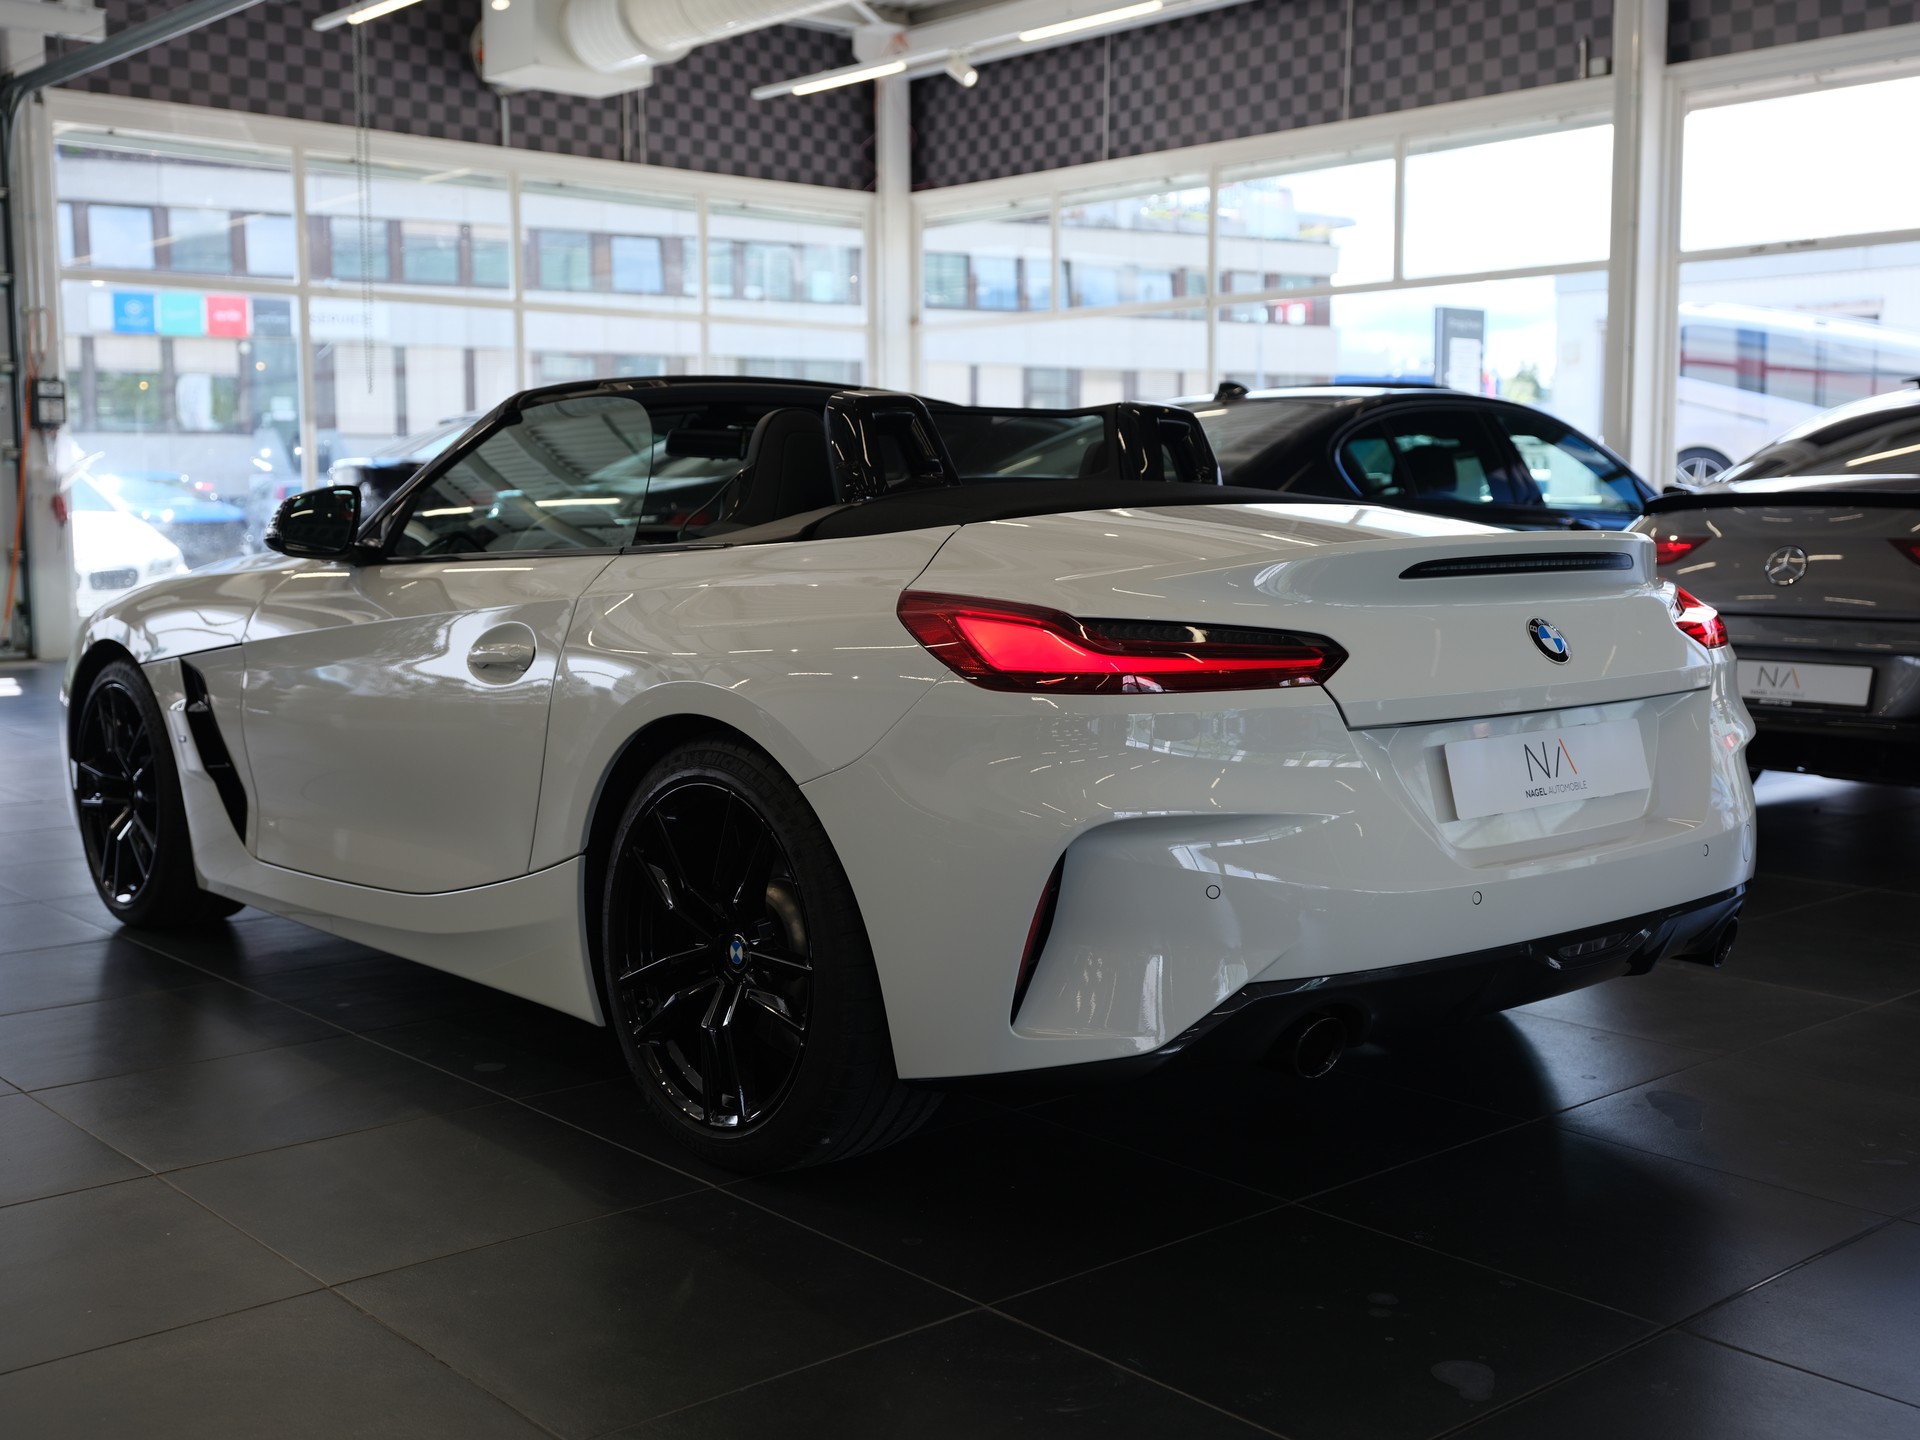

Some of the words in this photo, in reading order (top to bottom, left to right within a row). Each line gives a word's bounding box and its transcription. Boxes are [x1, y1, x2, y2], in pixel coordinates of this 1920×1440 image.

[1524, 738, 1578, 782] NA
[1525, 787, 1548, 798] NAGEL
[1548, 780, 1588, 795] AUTOMOBILE
